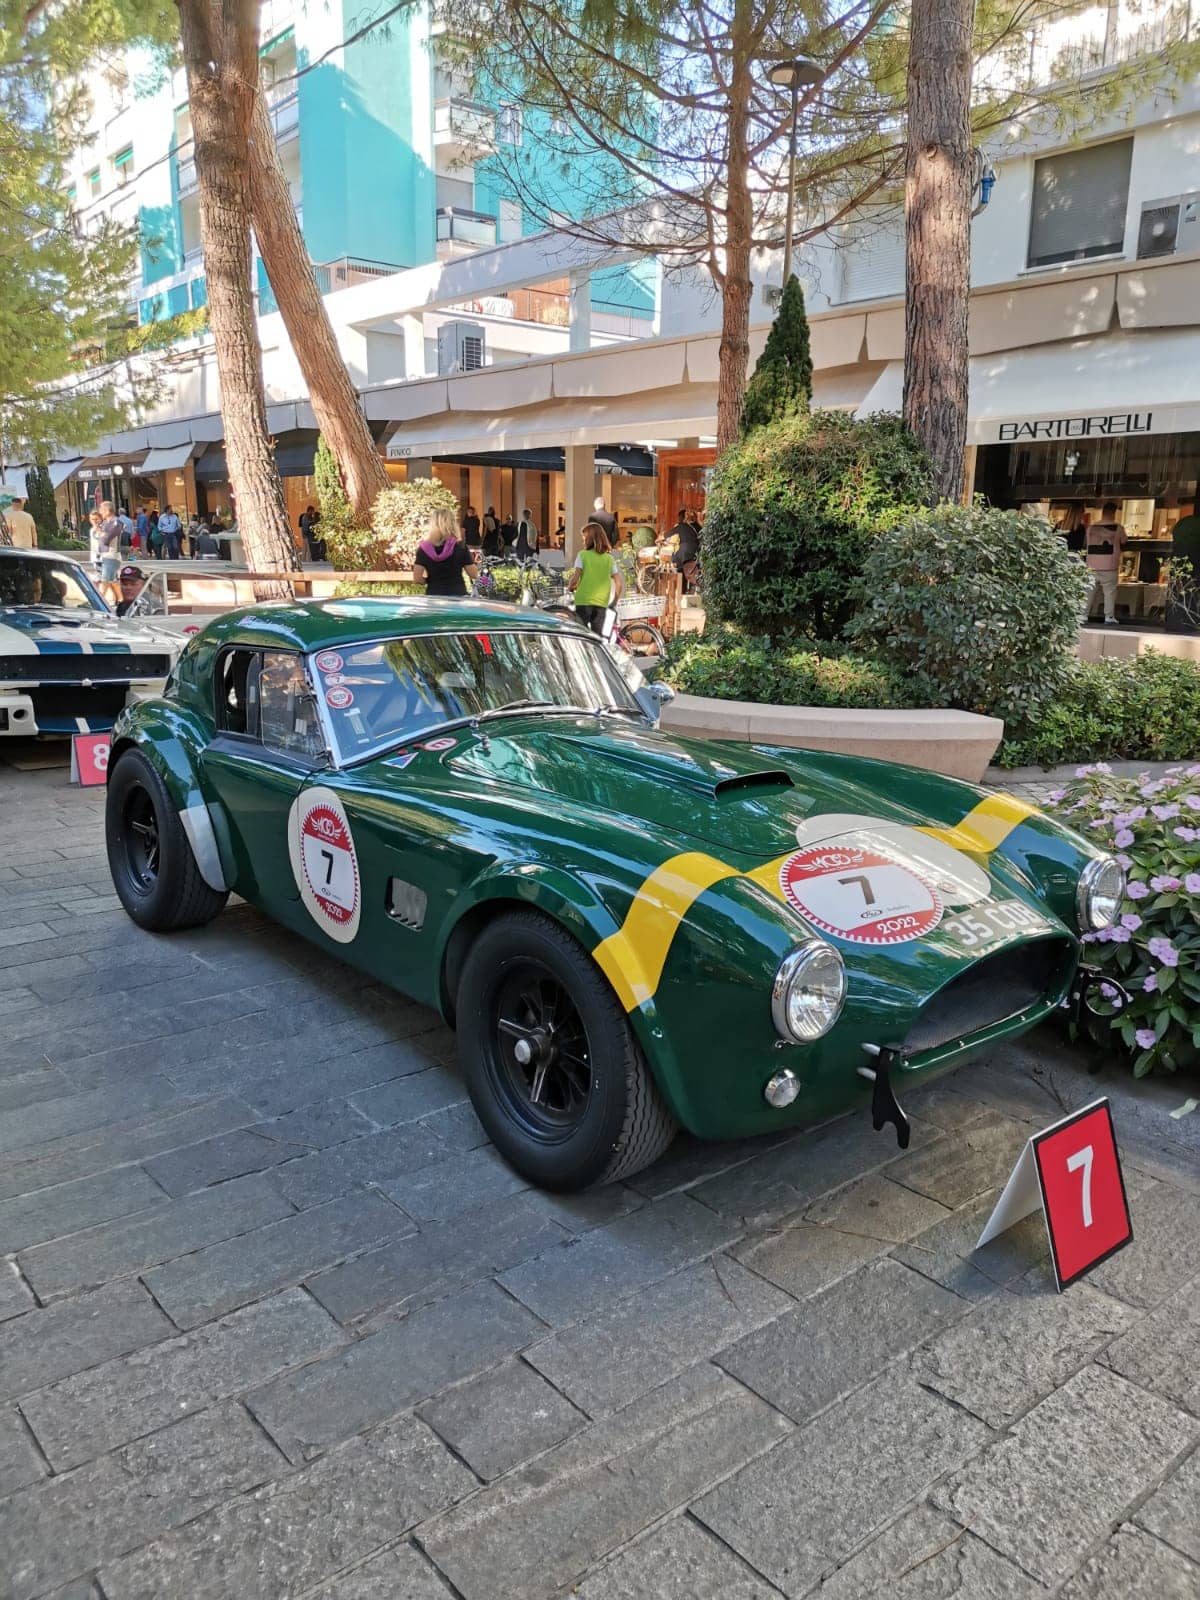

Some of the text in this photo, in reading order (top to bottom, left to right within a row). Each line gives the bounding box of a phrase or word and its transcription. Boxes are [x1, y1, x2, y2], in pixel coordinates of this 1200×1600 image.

[999, 412, 1152, 440] BARTORELLI
[93, 743, 110, 771] 8
[321, 849, 334, 885] 7
[838, 875, 876, 905] 7
[877, 915, 920, 935] 2022
[944, 914, 994, 946] 35
[1066, 1144, 1094, 1228] 7
